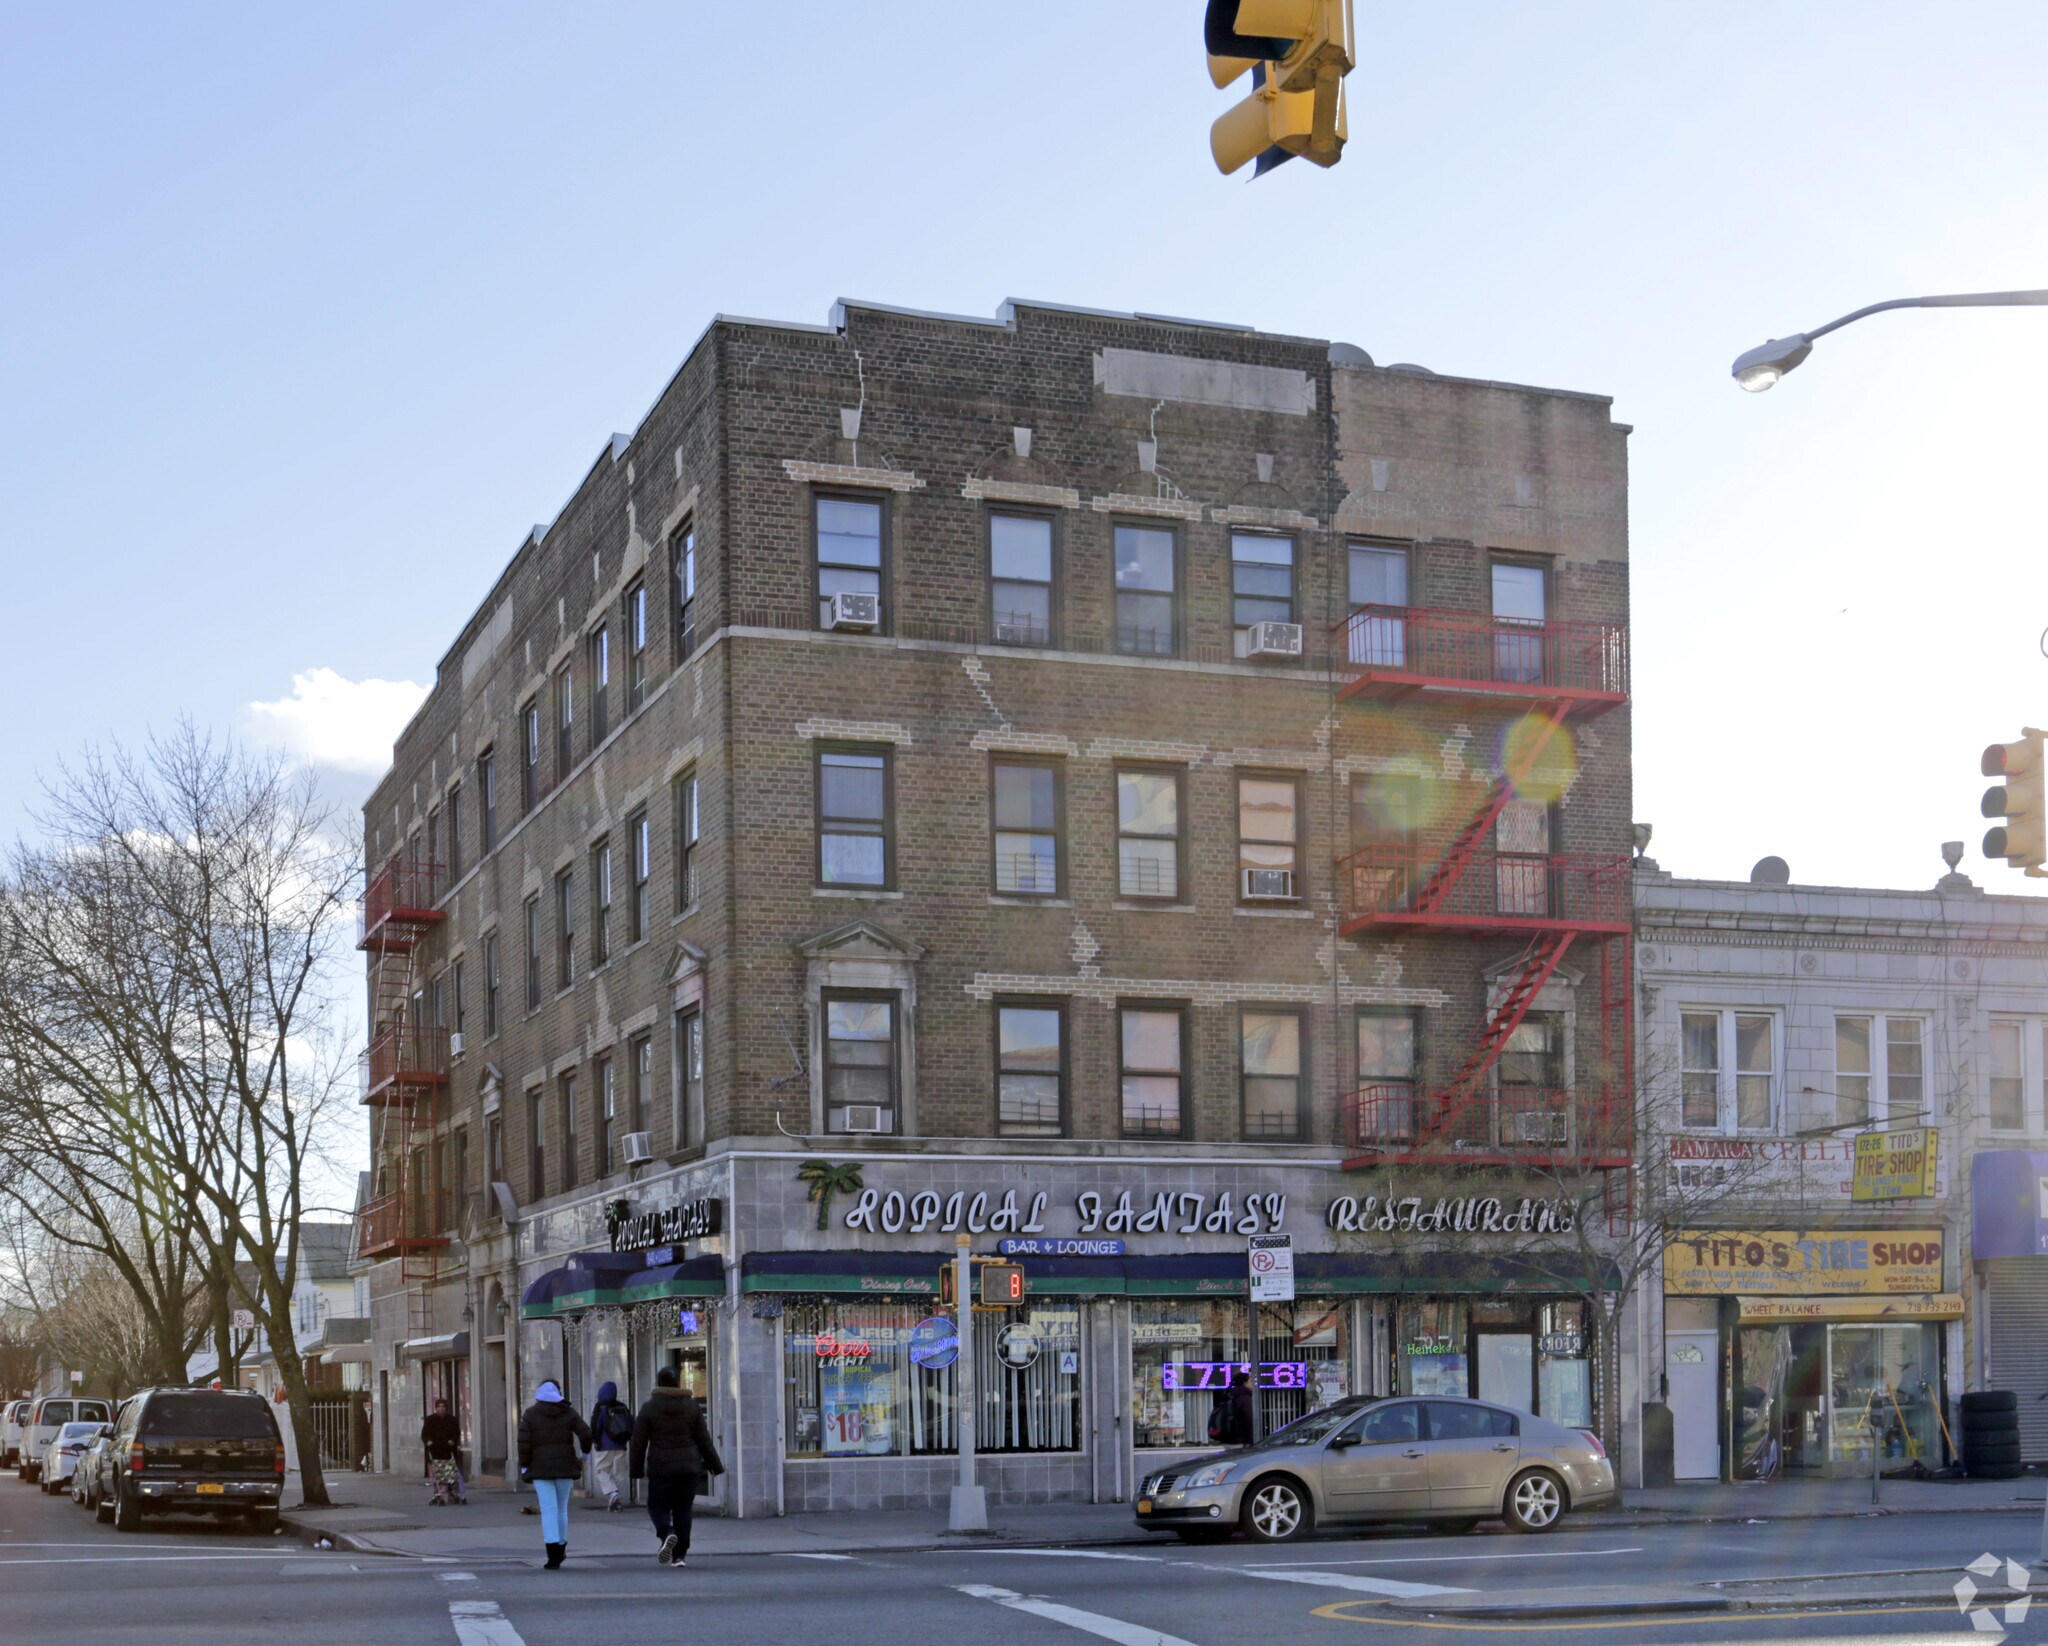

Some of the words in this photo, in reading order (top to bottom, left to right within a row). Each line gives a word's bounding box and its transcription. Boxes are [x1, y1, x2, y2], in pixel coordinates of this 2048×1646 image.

[1672, 1141, 1752, 1159] JAMAICA
[1759, 1141, 1835, 1160] CELL
[1889, 1132, 1919, 1149] TITO'S
[1857, 1154, 1883, 1176] TIRE
[1889, 1151, 1922, 1174] SHOP
[661, 1198, 710, 1242] FANTASY
[1078, 1191, 1287, 1235] FANTASY
[1006, 1240, 1038, 1254] BAR
[1057, 1240, 1118, 1254] LOUNGE
[1796, 1239, 1869, 1271] TIRE
[1873, 1242, 1941, 1266] SHOP
[861, 1278, 901, 1292] Dining
[904, 1279, 932, 1291] Only
[1011, 1274, 1020, 1298] 8
[815, 1335, 872, 1357] Coors
[1407, 1343, 1459, 1355] Heineken
[818, 1357, 867, 1369] LIGHT
[1063, 1355, 1074, 1367] A
[826, 1409, 863, 1443] $18
